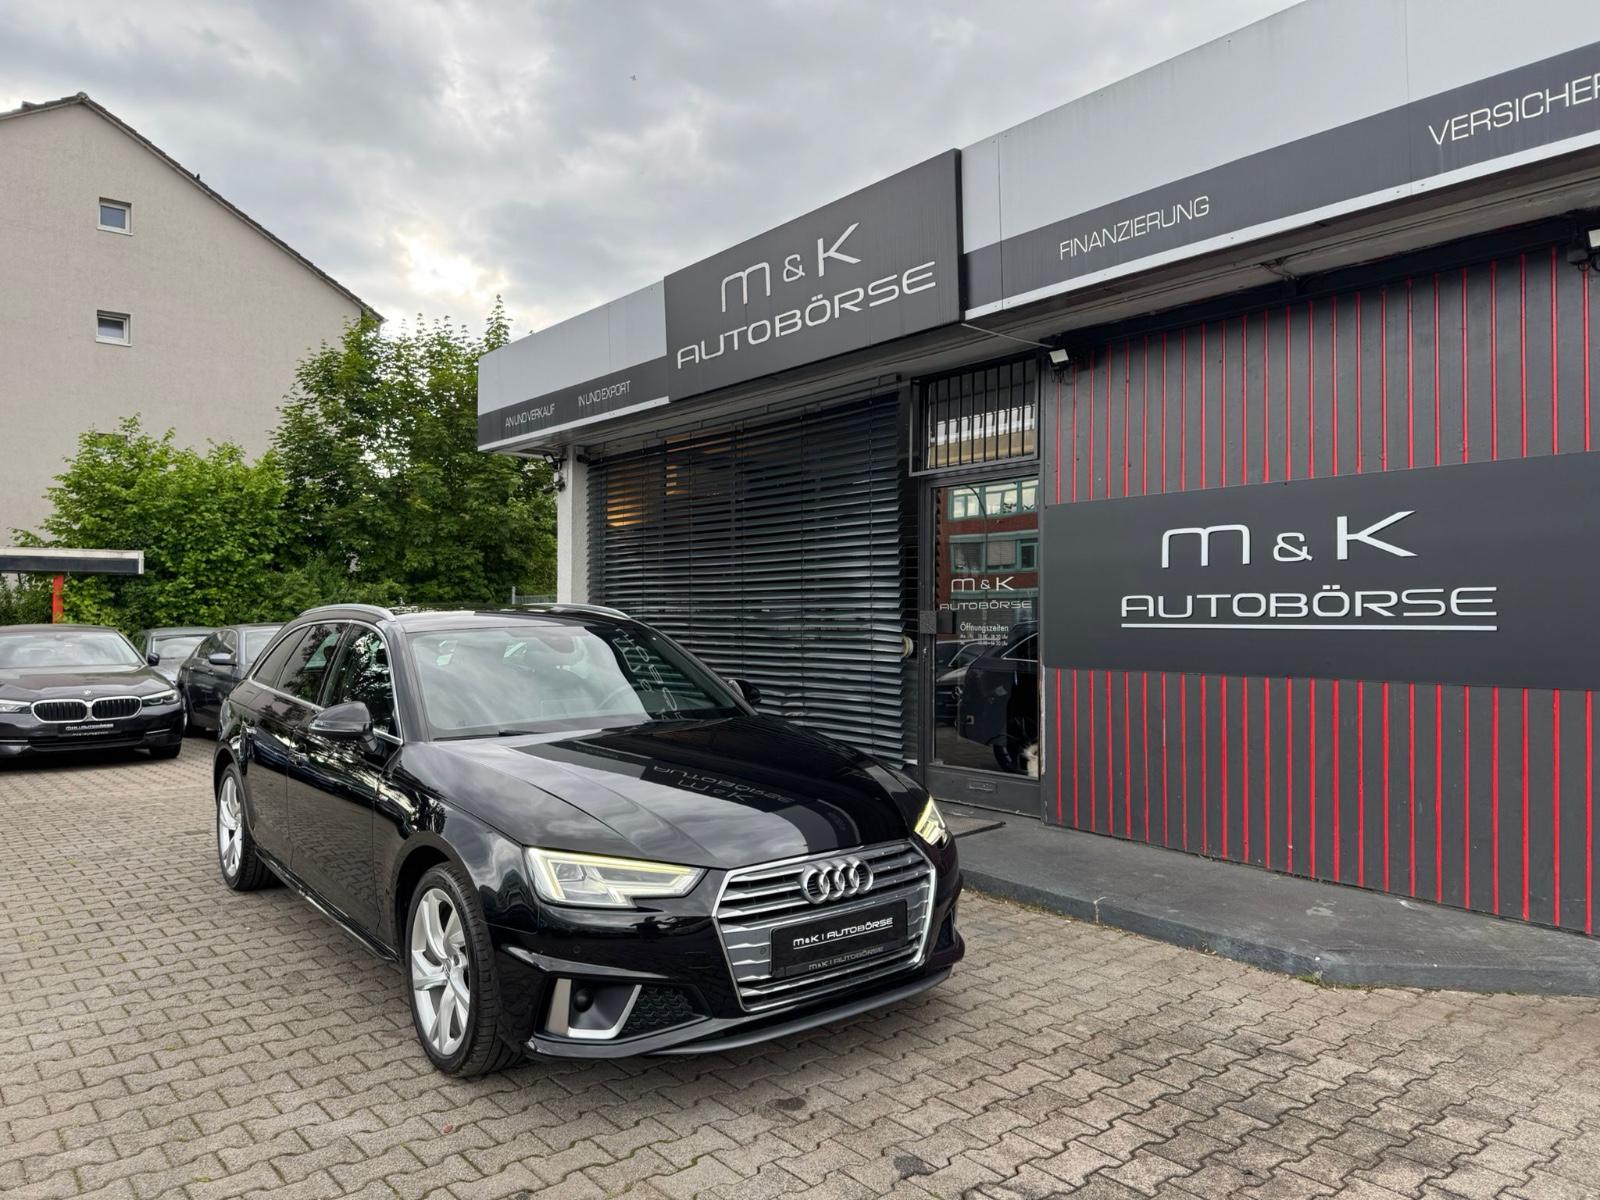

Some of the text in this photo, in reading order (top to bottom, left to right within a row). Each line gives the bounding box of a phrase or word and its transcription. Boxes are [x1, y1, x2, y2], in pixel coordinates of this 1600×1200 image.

[1060, 195, 1209, 260] FINANZIERUNG
[783, 254, 806, 282] &
[817, 222, 862, 277] K
[677, 261, 937, 369] AUTOBÖRSE
[1273, 532, 1313, 562] &
[1337, 510, 1418, 561] K
[980, 579, 991, 590] &
[995, 576, 1015, 591] K
[1122, 584, 1497, 618] AUTOBÖRSE
[940, 600, 1032, 611] AUTOBÖRSE
[827, 917, 894, 939] AUTOBÖRSE
